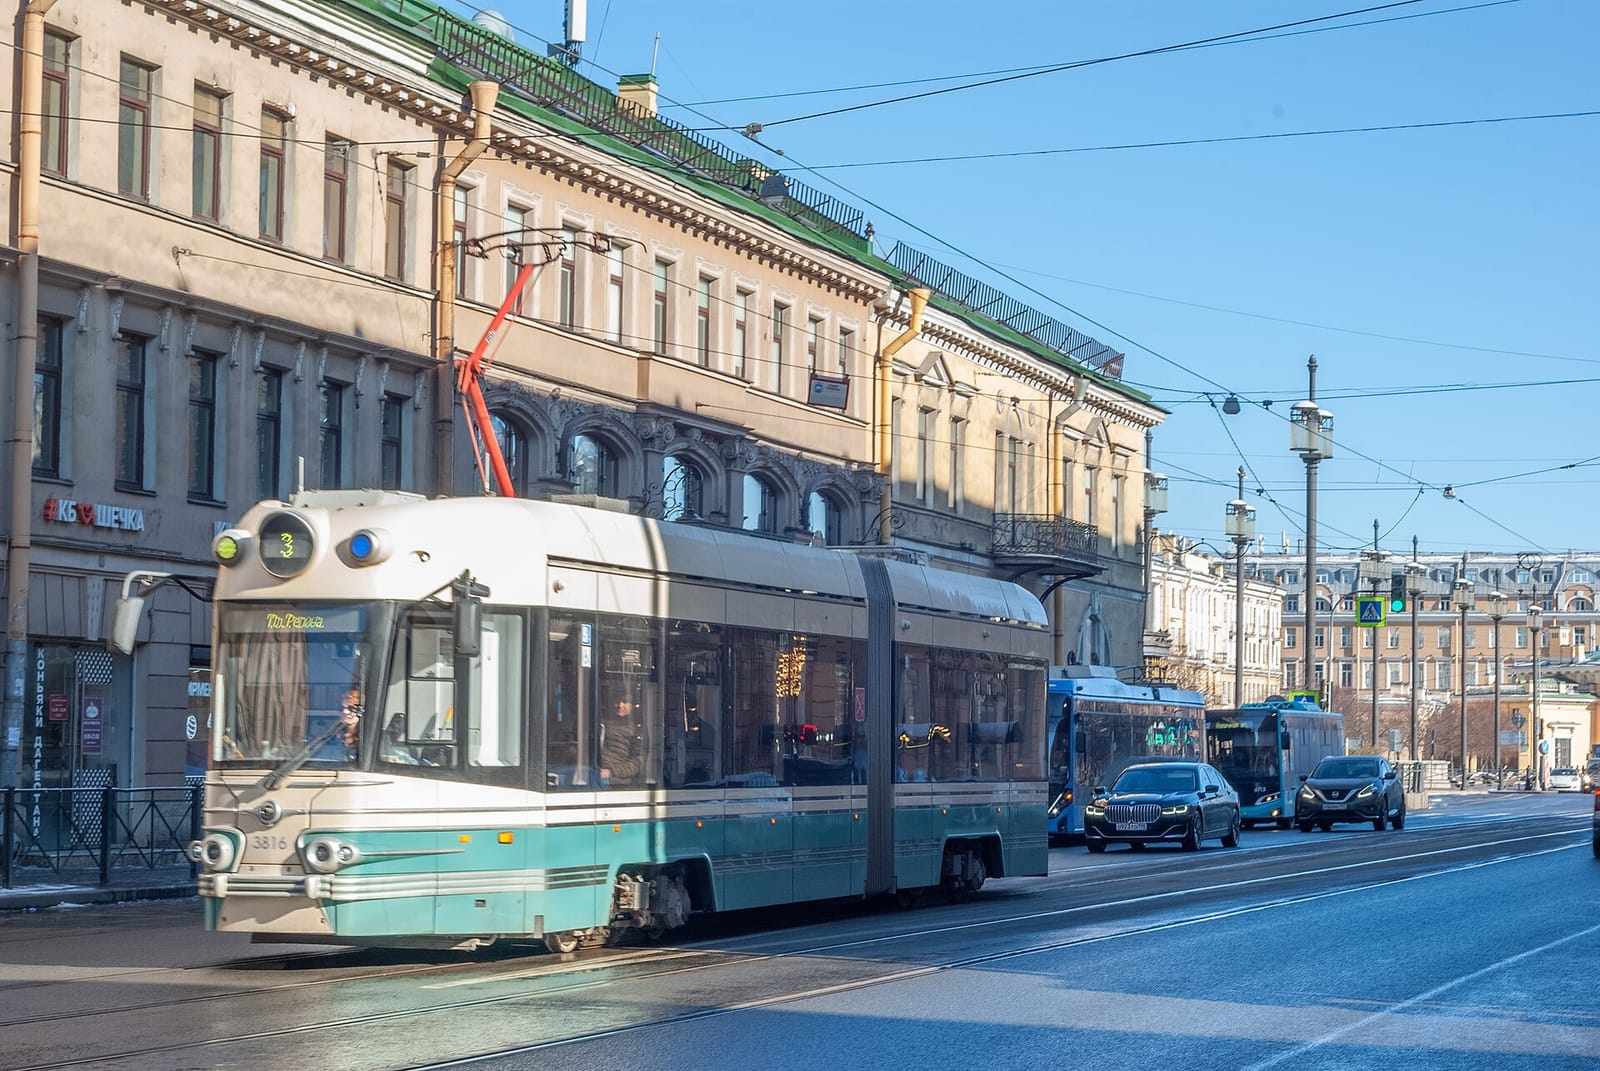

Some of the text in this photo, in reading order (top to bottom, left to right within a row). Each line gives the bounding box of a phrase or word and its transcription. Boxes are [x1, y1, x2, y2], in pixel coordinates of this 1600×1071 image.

[280, 532, 294, 559] 3
[36, 648, 46, 728] КОНЬЯКИ
[252, 835, 288, 850] 3816
